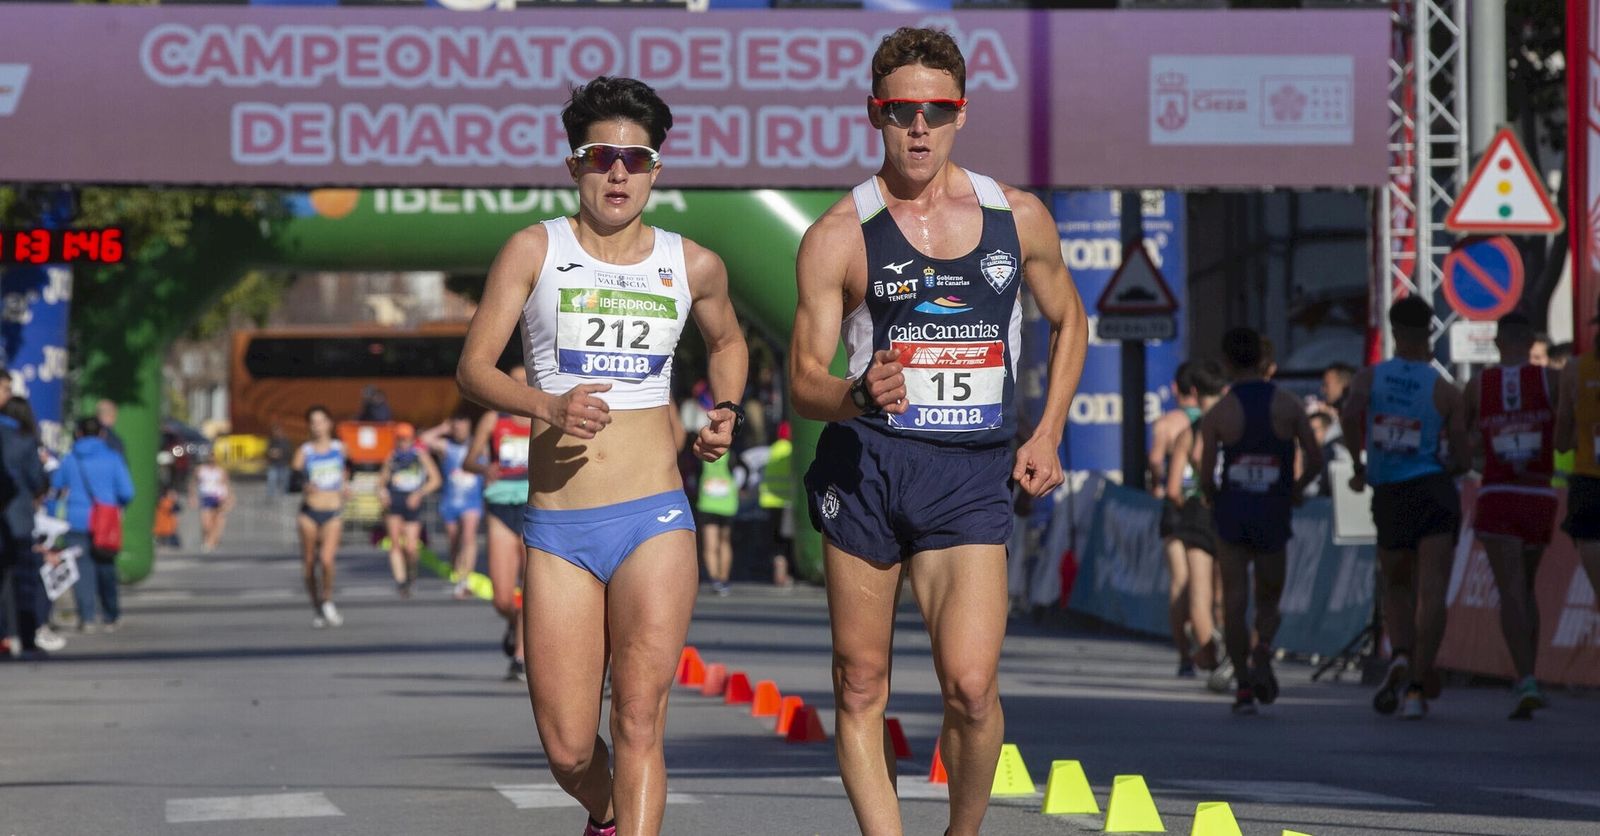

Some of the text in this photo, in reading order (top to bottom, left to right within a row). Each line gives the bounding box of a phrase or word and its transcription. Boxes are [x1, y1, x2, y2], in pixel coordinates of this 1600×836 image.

[142, 20, 1017, 90] CAMPEONATO DE ESPA
[233, 105, 885, 167] DE MARCH EN RUT
[373, 188, 687, 214] IBERDRA
[886, 279, 919, 295] DXT
[888, 292, 917, 302] TENERIFE
[599, 297, 668, 313] IBERDROLA
[585, 317, 650, 350] 212
[888, 320, 1000, 342] CajaCanarias
[582, 353, 651, 374] Joma
[937, 358, 986, 366] ATLETISMO
[940, 347, 990, 360] RFEA
[930, 372, 972, 402] 15
[914, 407, 984, 427] Joma
